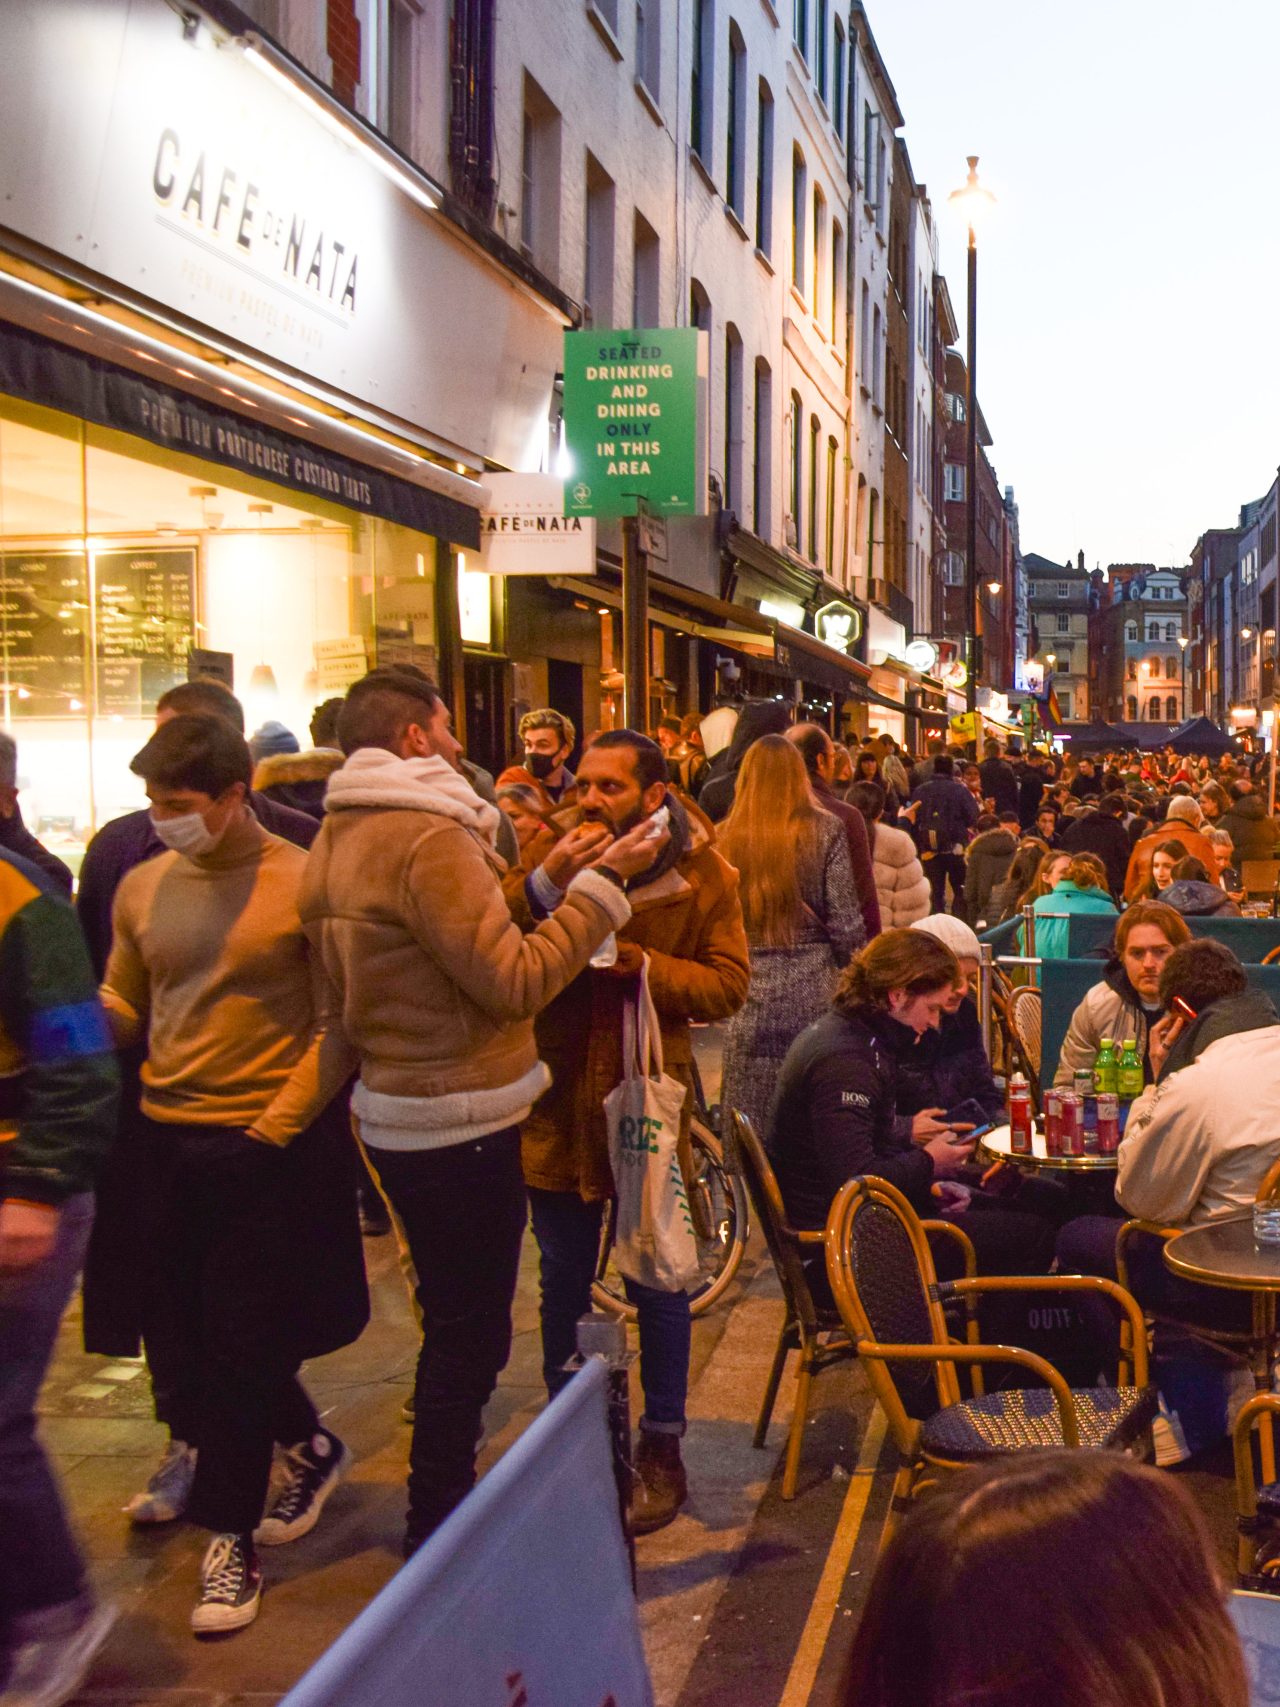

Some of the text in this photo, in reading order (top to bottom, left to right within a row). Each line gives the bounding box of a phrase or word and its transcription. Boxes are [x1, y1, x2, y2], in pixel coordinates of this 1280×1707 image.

[284, 213, 358, 312] NATA
[599, 346, 662, 361] SEATED
[586, 364, 673, 381] DRINKING
[611, 384, 648, 399] AND
[597, 403, 661, 418] DINING
[606, 423, 651, 437] ONLY
[139, 398, 212, 449] PREMIUM
[216, 427, 290, 478] PORTUGUESE
[294, 456, 340, 494] CUSTARD
[597, 441, 660, 457] IN THIS
[607, 461, 651, 476] AREA
[523, 519, 534, 528] DE
[537, 516, 582, 531] NATA
[841, 1091, 871, 1105] BOSS
